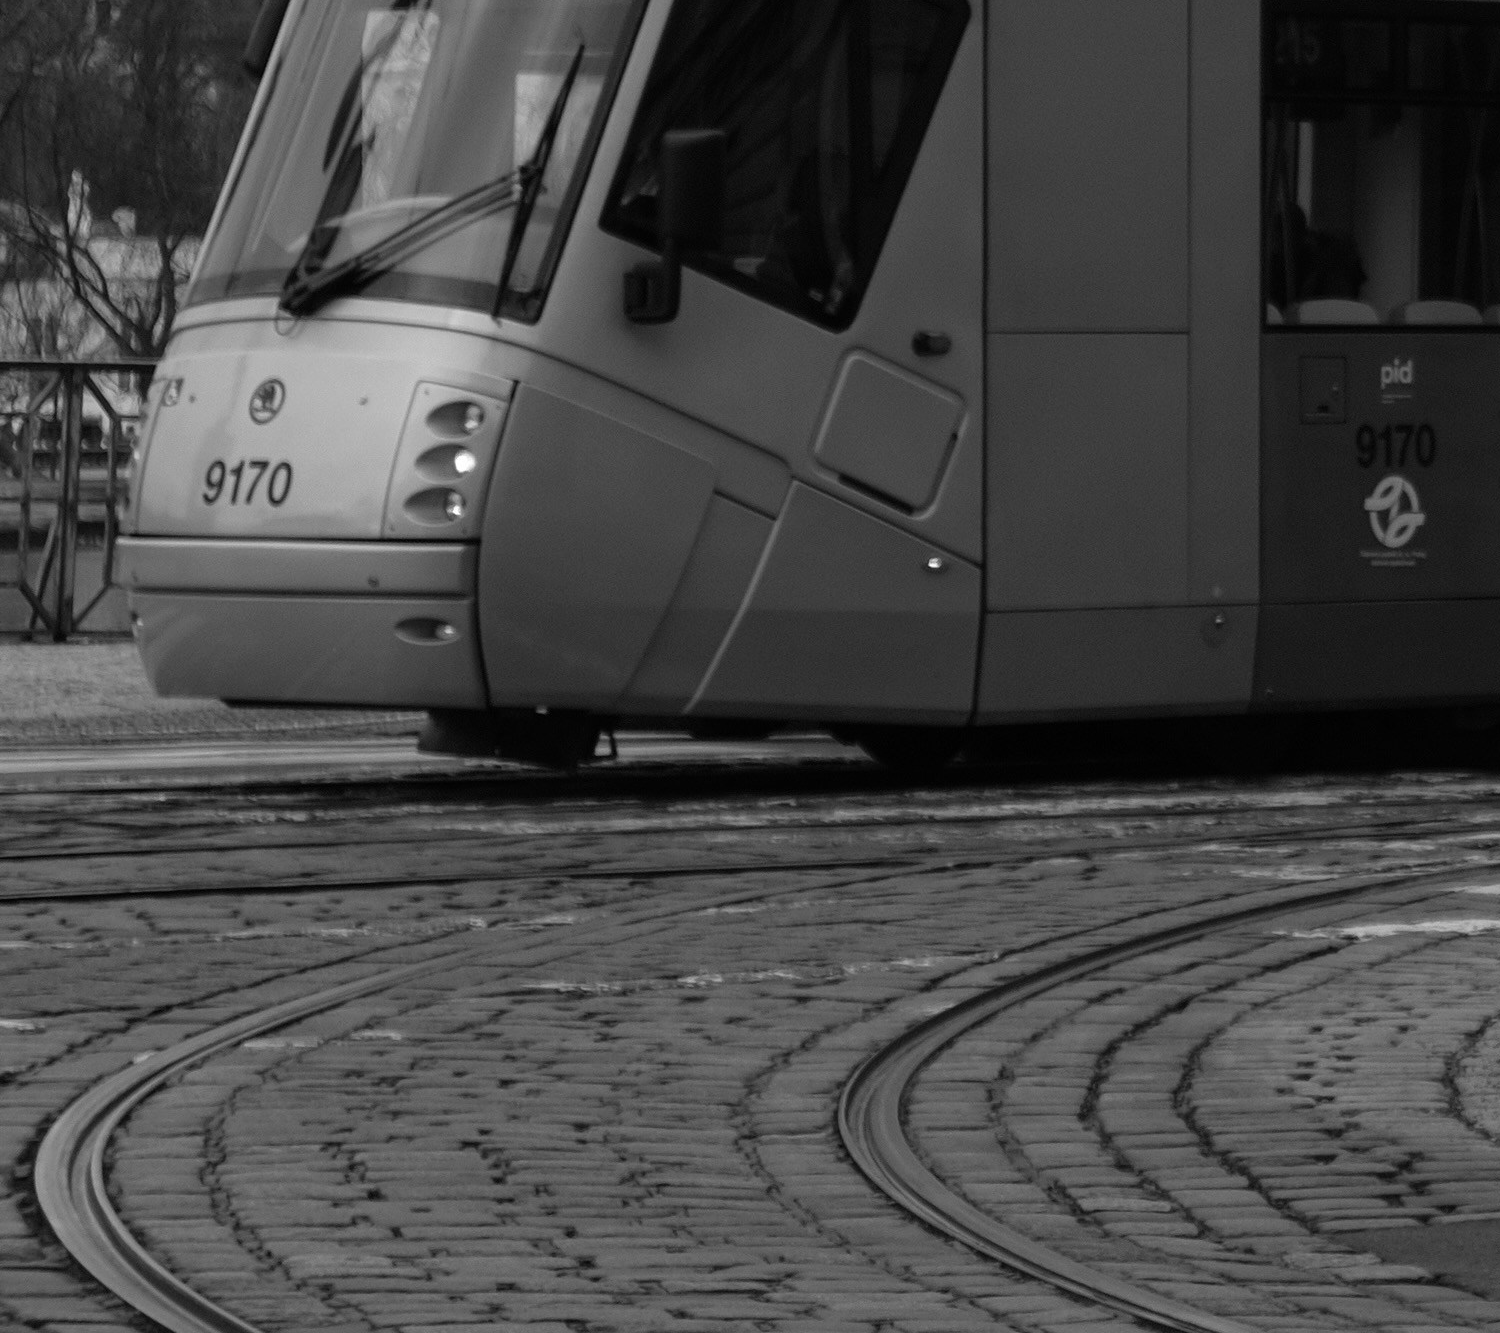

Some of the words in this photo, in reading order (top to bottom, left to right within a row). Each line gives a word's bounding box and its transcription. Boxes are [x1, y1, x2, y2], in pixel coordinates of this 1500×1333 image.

[1381, 358, 1414, 389] pid
[1356, 423, 1437, 468] 9170
[202, 458, 293, 508] 9170
